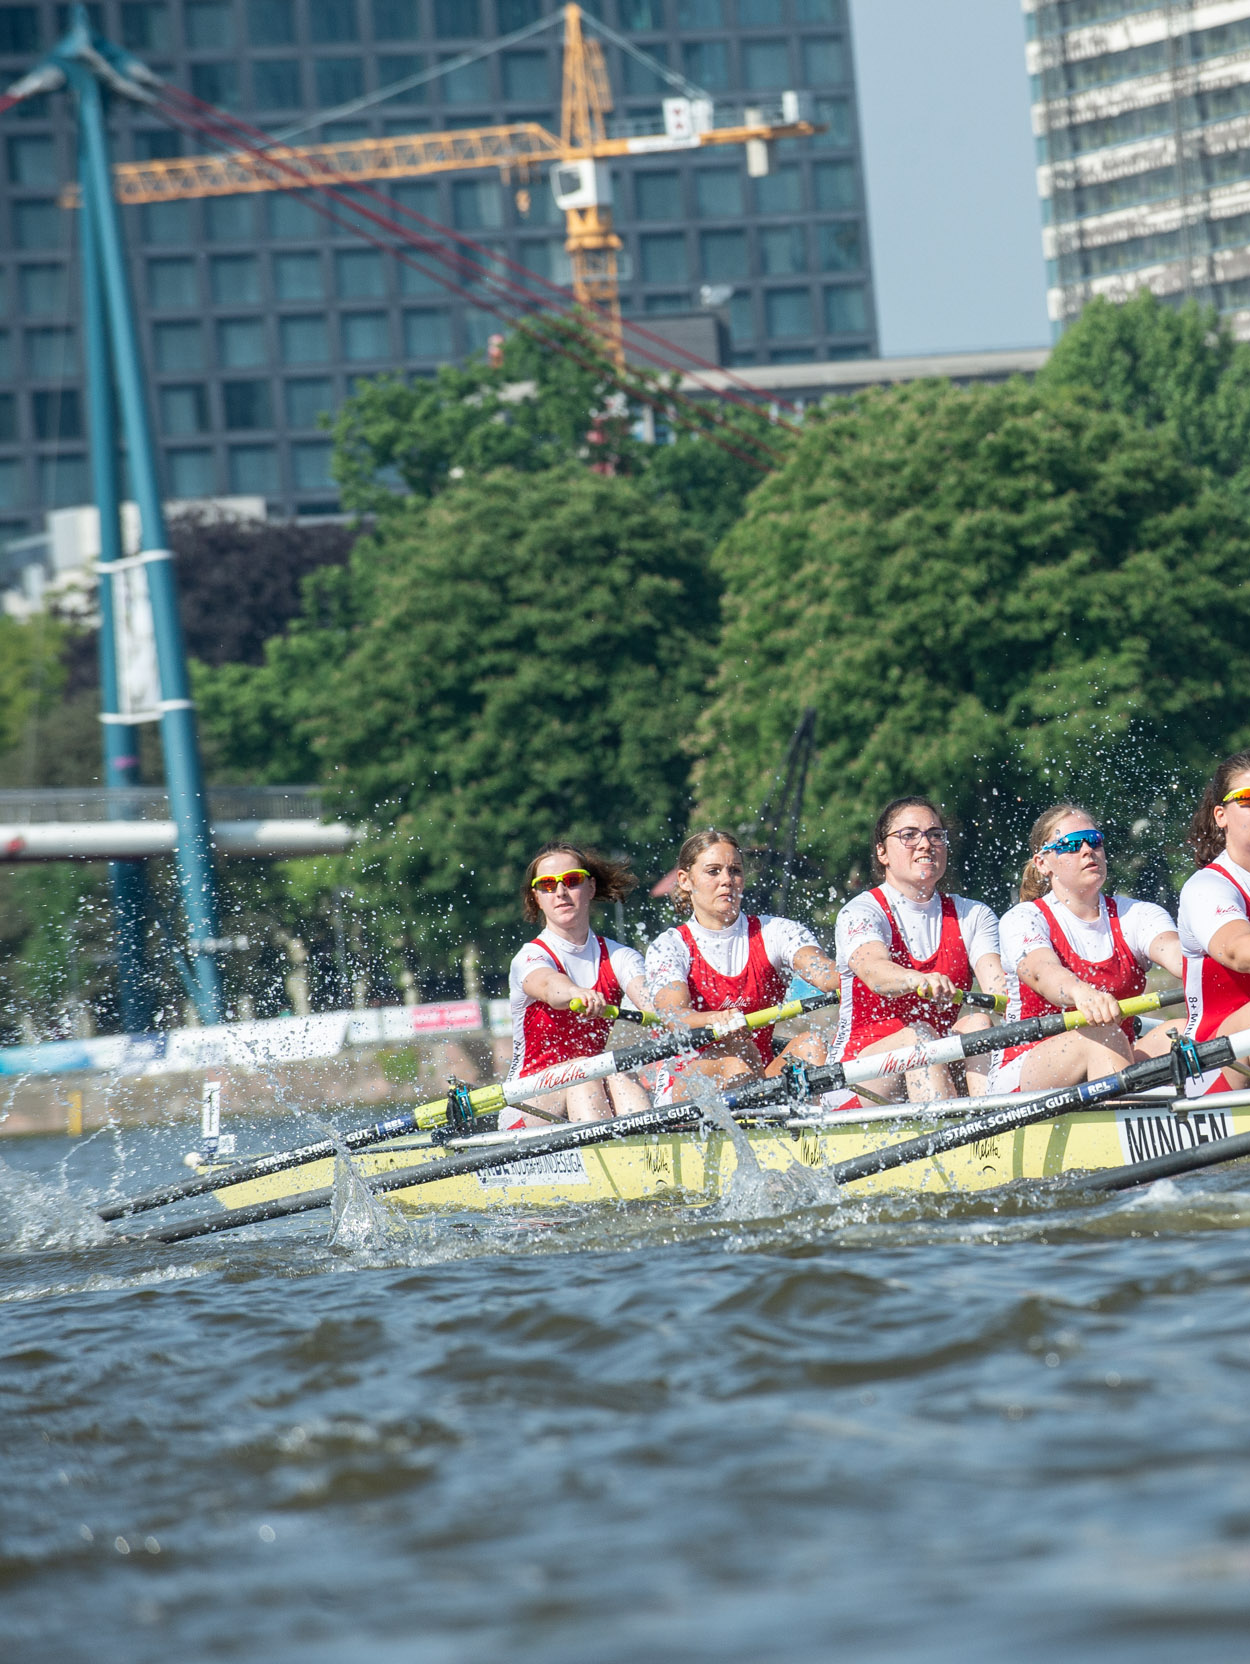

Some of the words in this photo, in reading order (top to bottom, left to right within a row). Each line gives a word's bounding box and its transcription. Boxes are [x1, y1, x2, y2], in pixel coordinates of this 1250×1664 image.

[1188, 996, 1199, 1010] 8+
[532, 1063, 589, 1094] Melitta
[876, 1050, 931, 1077] Melitta
[572, 1124, 612, 1142] STARK.
[667, 1105, 696, 1119] GUT.
[944, 1121, 987, 1142] STARK.
[987, 1105, 1046, 1128] SCHNELL.
[1045, 1092, 1074, 1109] GUT.
[1124, 1112, 1229, 1165] MINDEN
